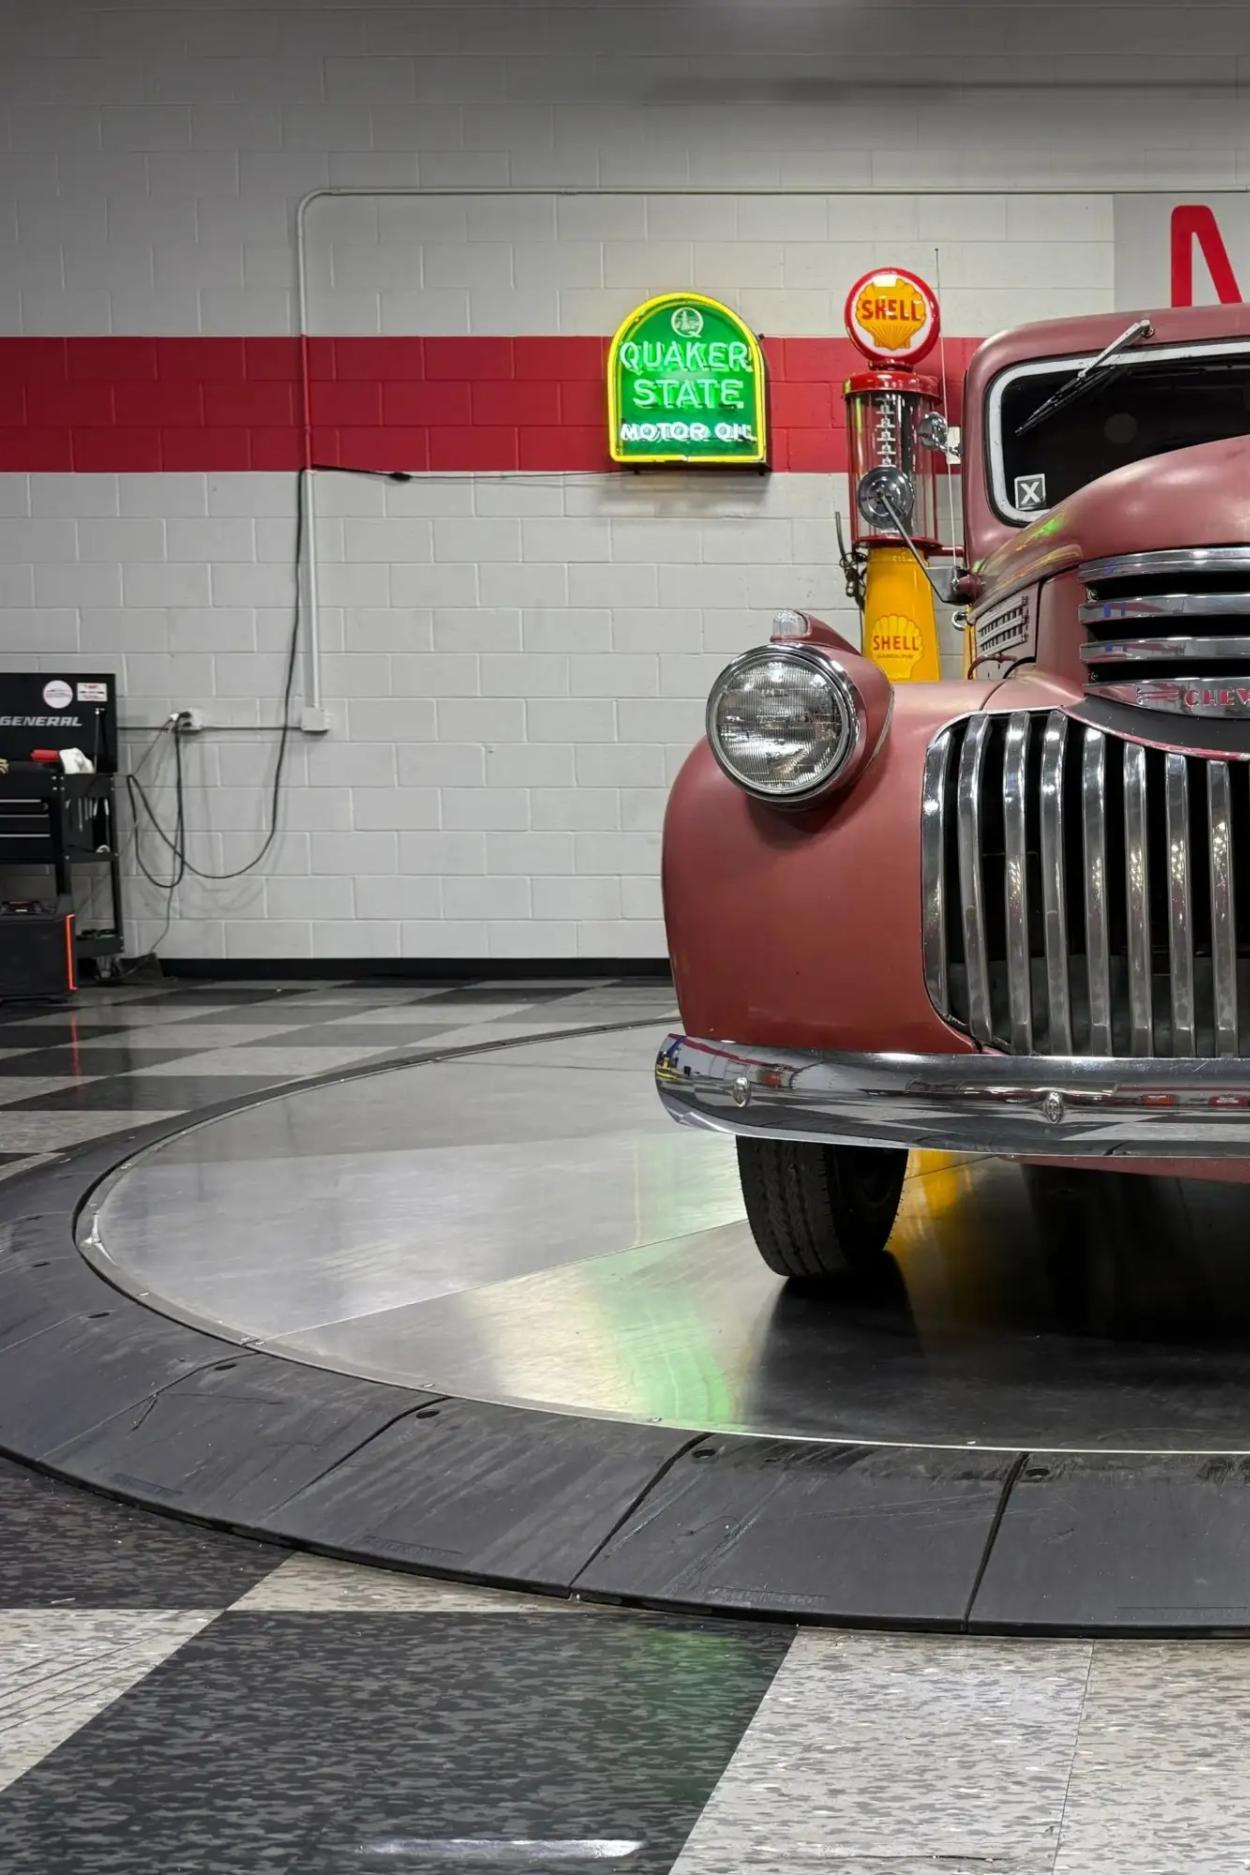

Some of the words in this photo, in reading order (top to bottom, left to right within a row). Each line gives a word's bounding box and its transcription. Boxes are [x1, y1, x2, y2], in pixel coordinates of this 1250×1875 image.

[861, 299, 921, 321] SHELL
[619, 340, 753, 376] QUAKER
[633, 379, 744, 409] STATE
[620, 422, 711, 443] MOTOR
[714, 422, 758, 442] OIL
[873, 635, 920, 651] SHELL
[0, 715, 82, 727] GENERAL
